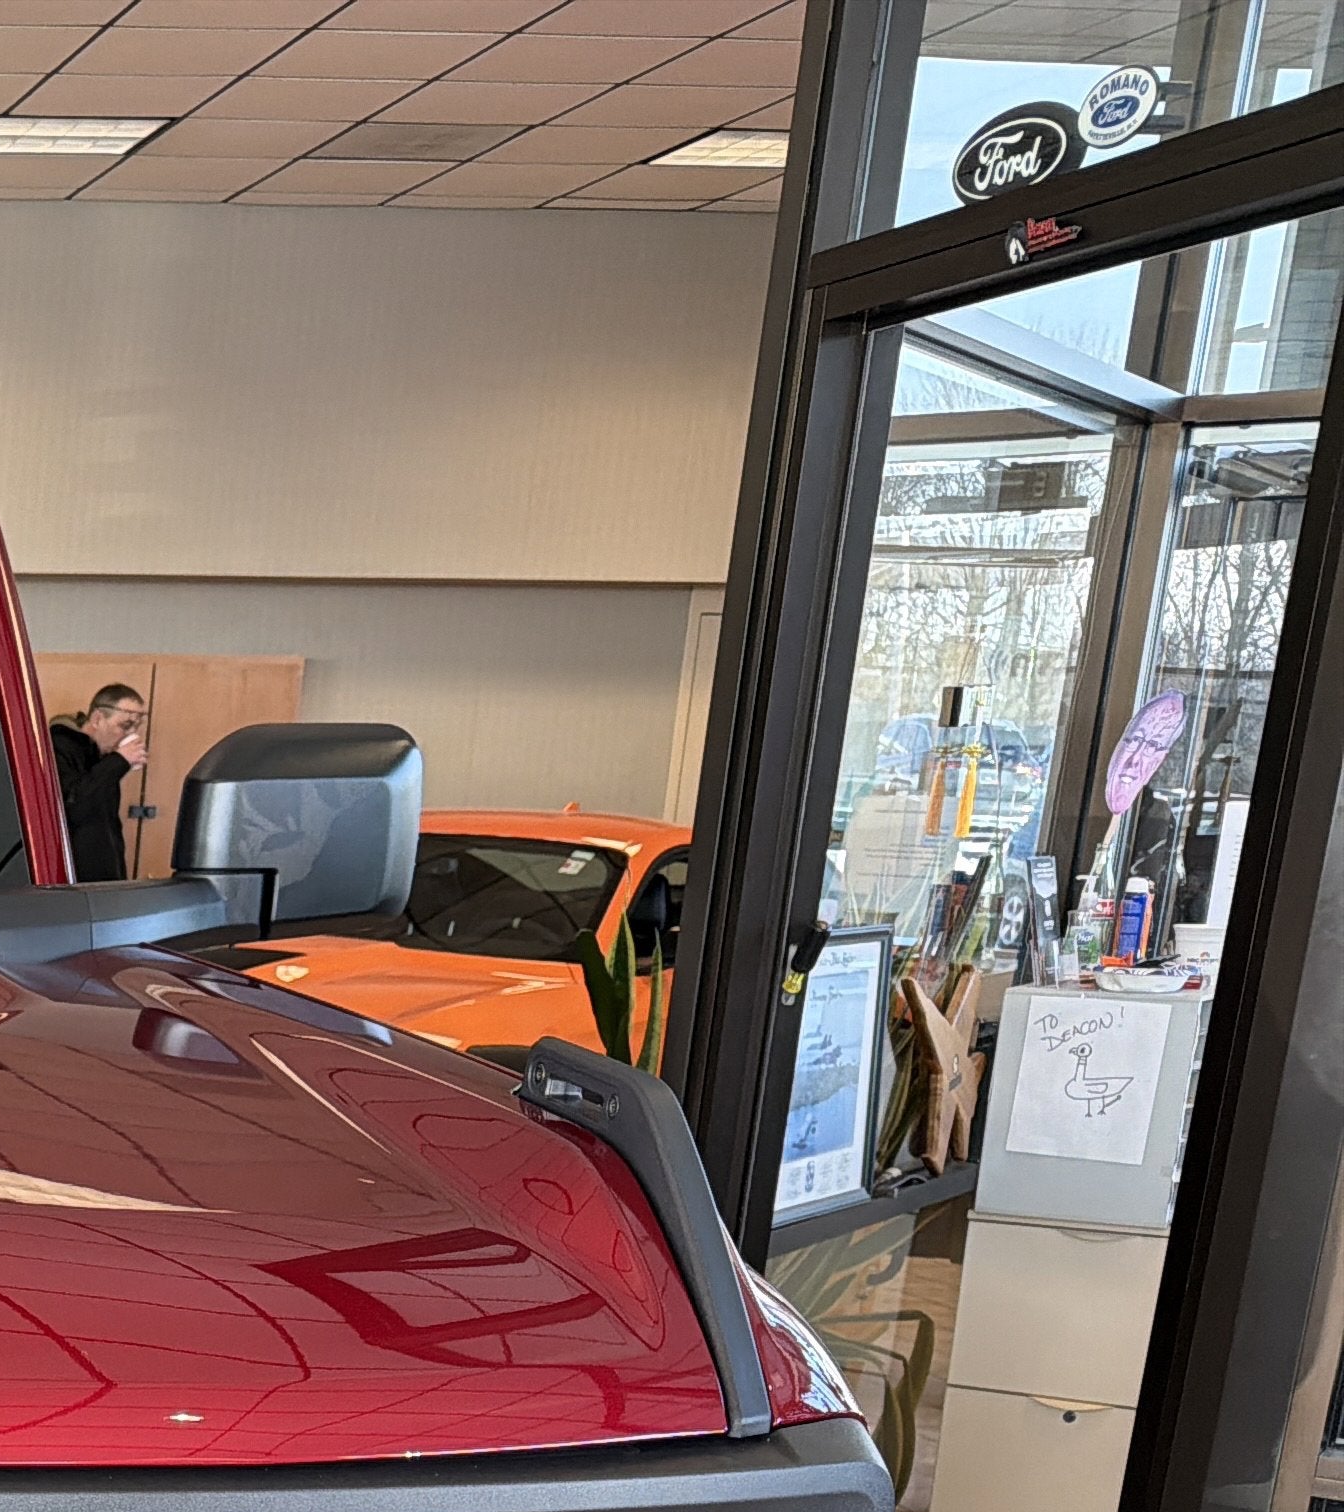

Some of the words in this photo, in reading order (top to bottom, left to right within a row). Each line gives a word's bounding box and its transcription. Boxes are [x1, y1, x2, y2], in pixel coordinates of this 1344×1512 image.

[1089, 74, 1150, 111] ROMANO
[1098, 99, 1133, 126] Ford
[974, 130, 1043, 191] Ford
[1033, 1013, 1059, 1034] TO
